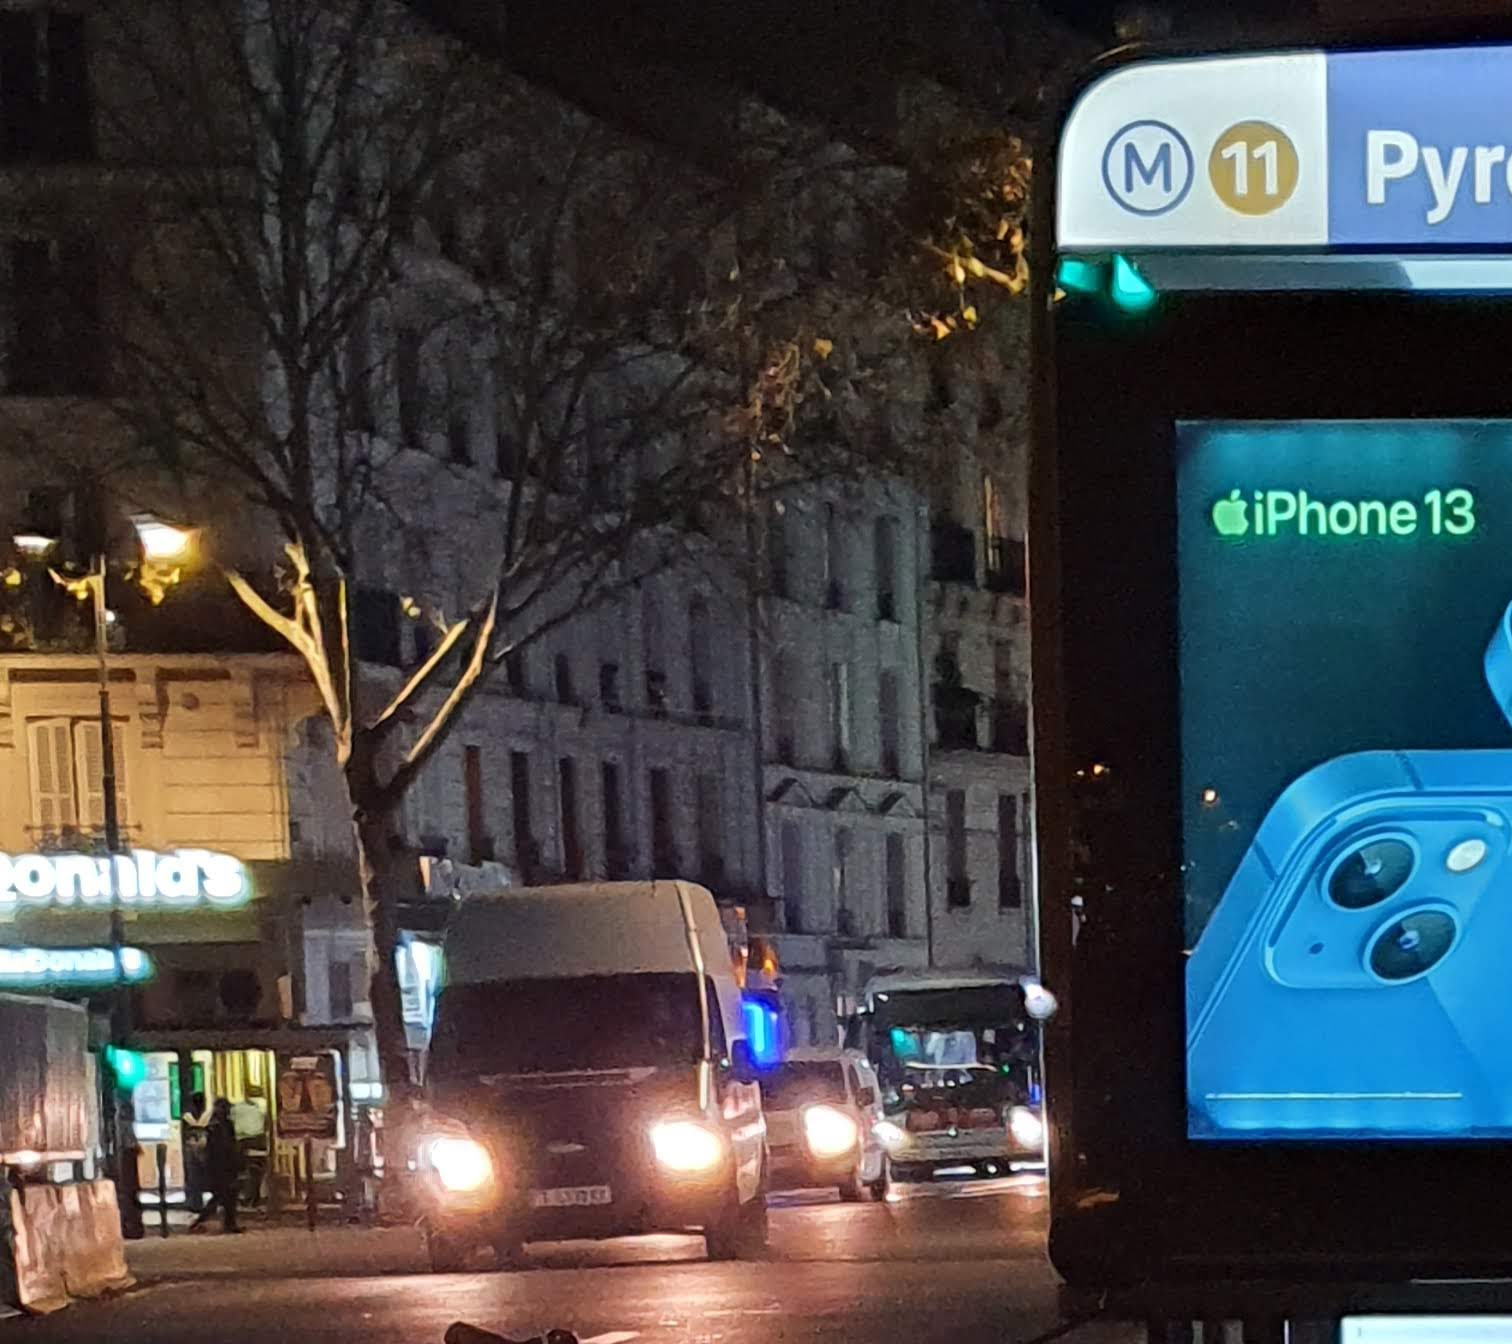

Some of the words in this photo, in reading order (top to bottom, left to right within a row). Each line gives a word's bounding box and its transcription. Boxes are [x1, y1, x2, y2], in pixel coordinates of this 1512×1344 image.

[1123, 142, 1172, 194] M
[1221, 141, 1278, 195] 11
[1253, 489, 1418, 535] iPhone
[1423, 488, 1476, 535] 13
